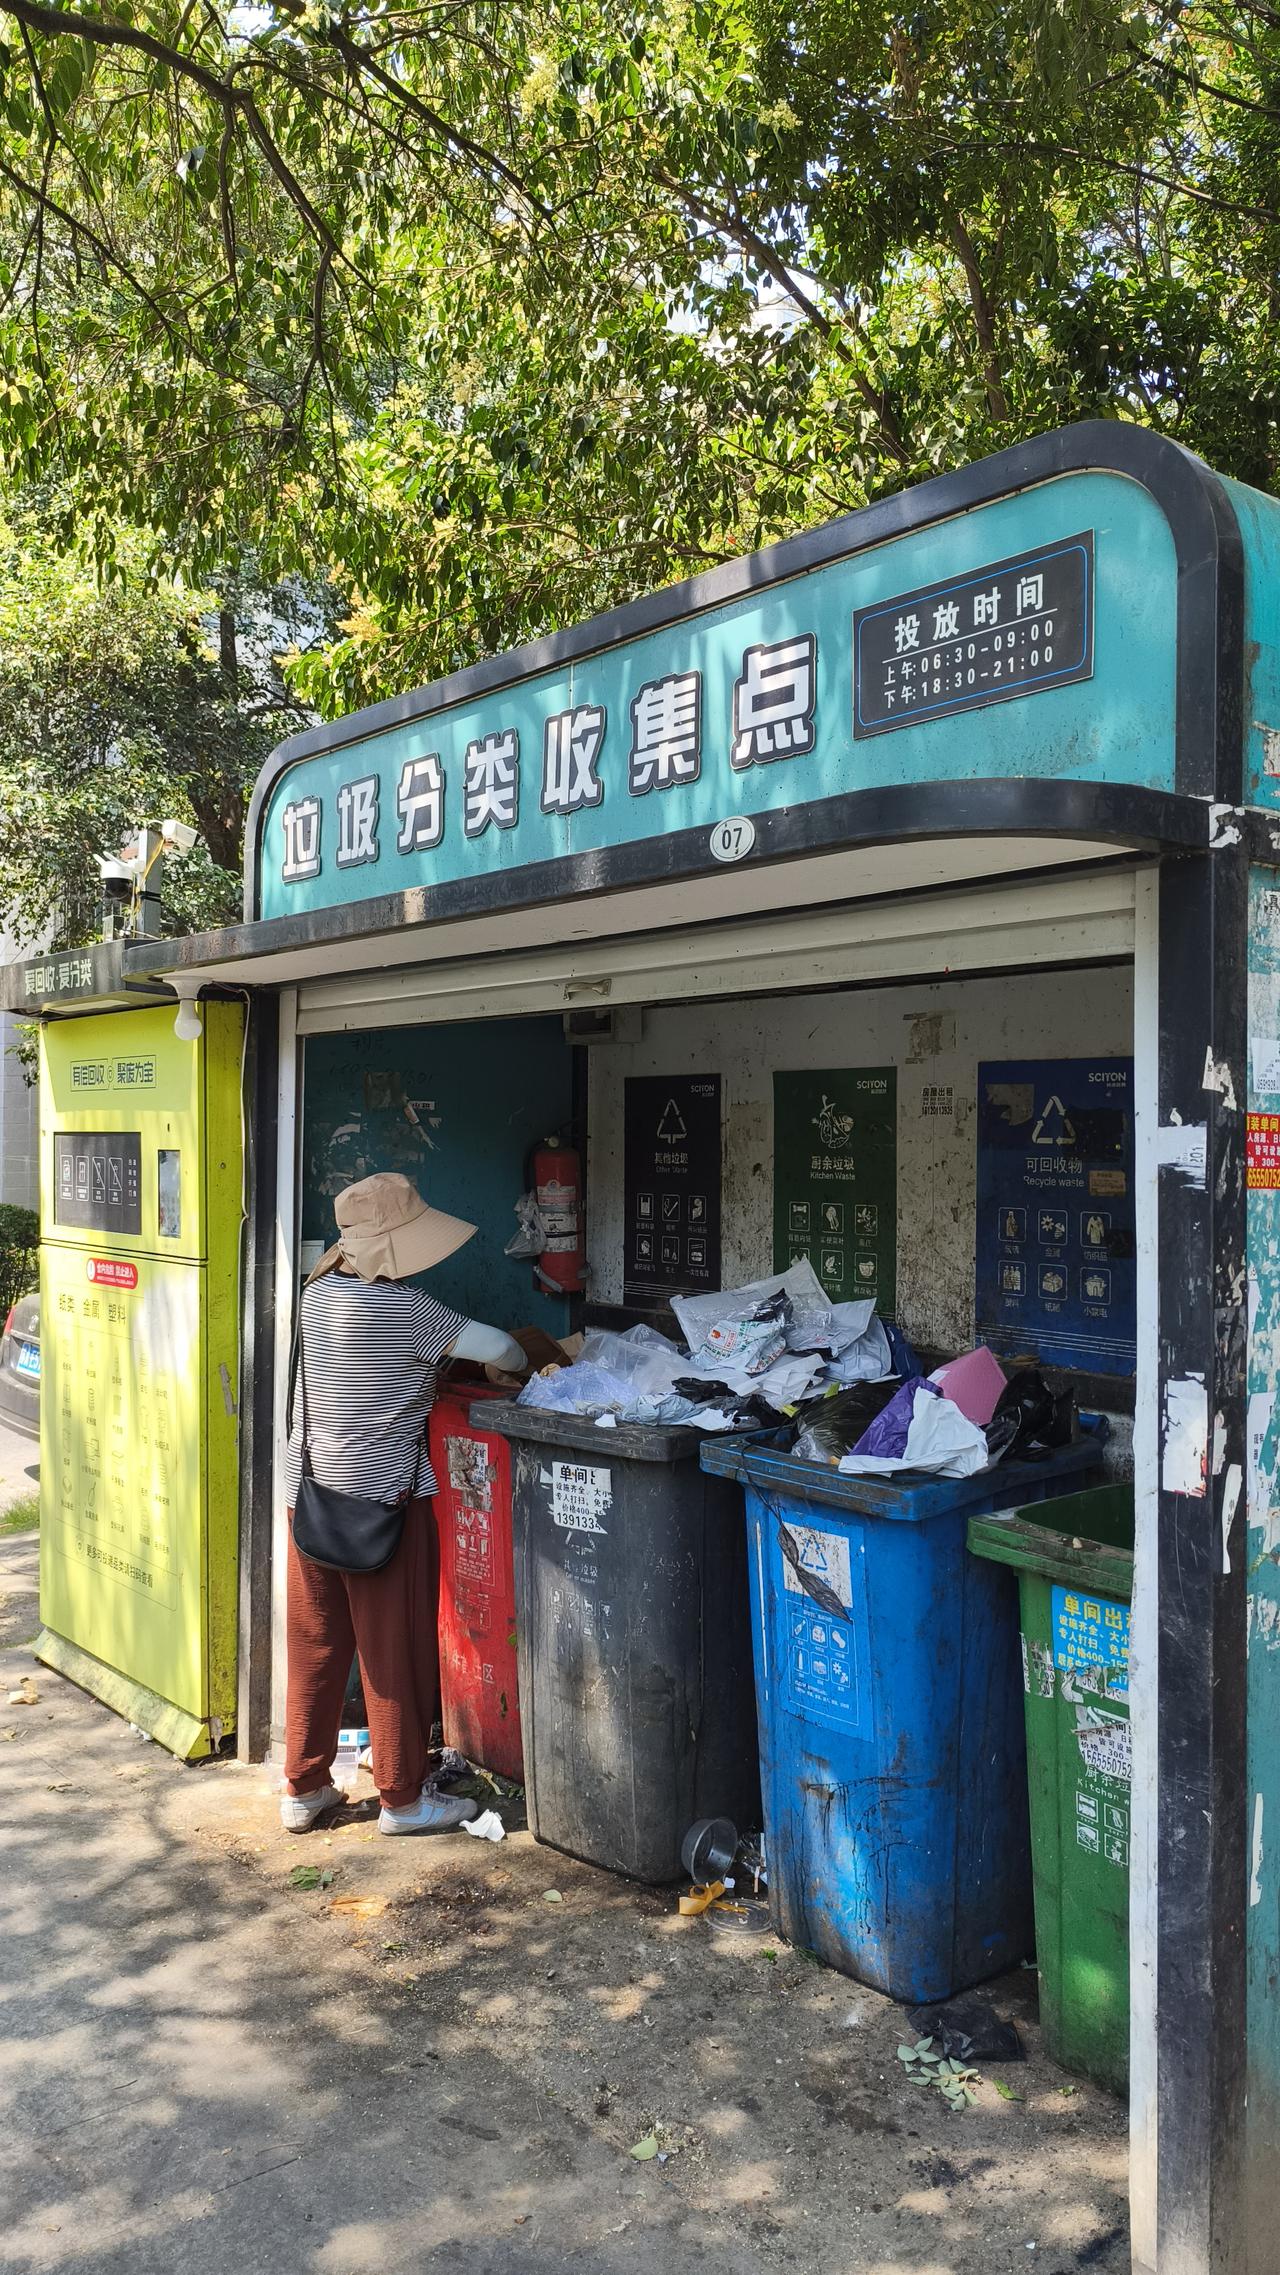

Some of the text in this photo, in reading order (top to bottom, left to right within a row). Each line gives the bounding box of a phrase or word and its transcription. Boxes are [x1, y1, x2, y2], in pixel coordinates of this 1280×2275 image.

[894, 573, 1044, 654] 投放时间
[282, 632, 818, 883] 垃圾分类收集点
[720, 826, 742, 852] 07
[117, 1060, 154, 1084] 聚废为宝
[811, 1155, 855, 1170] 厨余垃圾
[1026, 1156, 1083, 1173] 可回收物
[810, 1171, 856, 1181] Kitchen Waste
[1023, 1175, 1057, 1188] Recycle
[1058, 1177, 1085, 1188] waste
[564, 1559, 598, 1578] 其垃圾
[1077, 1778, 1120, 1801] Kitchen
